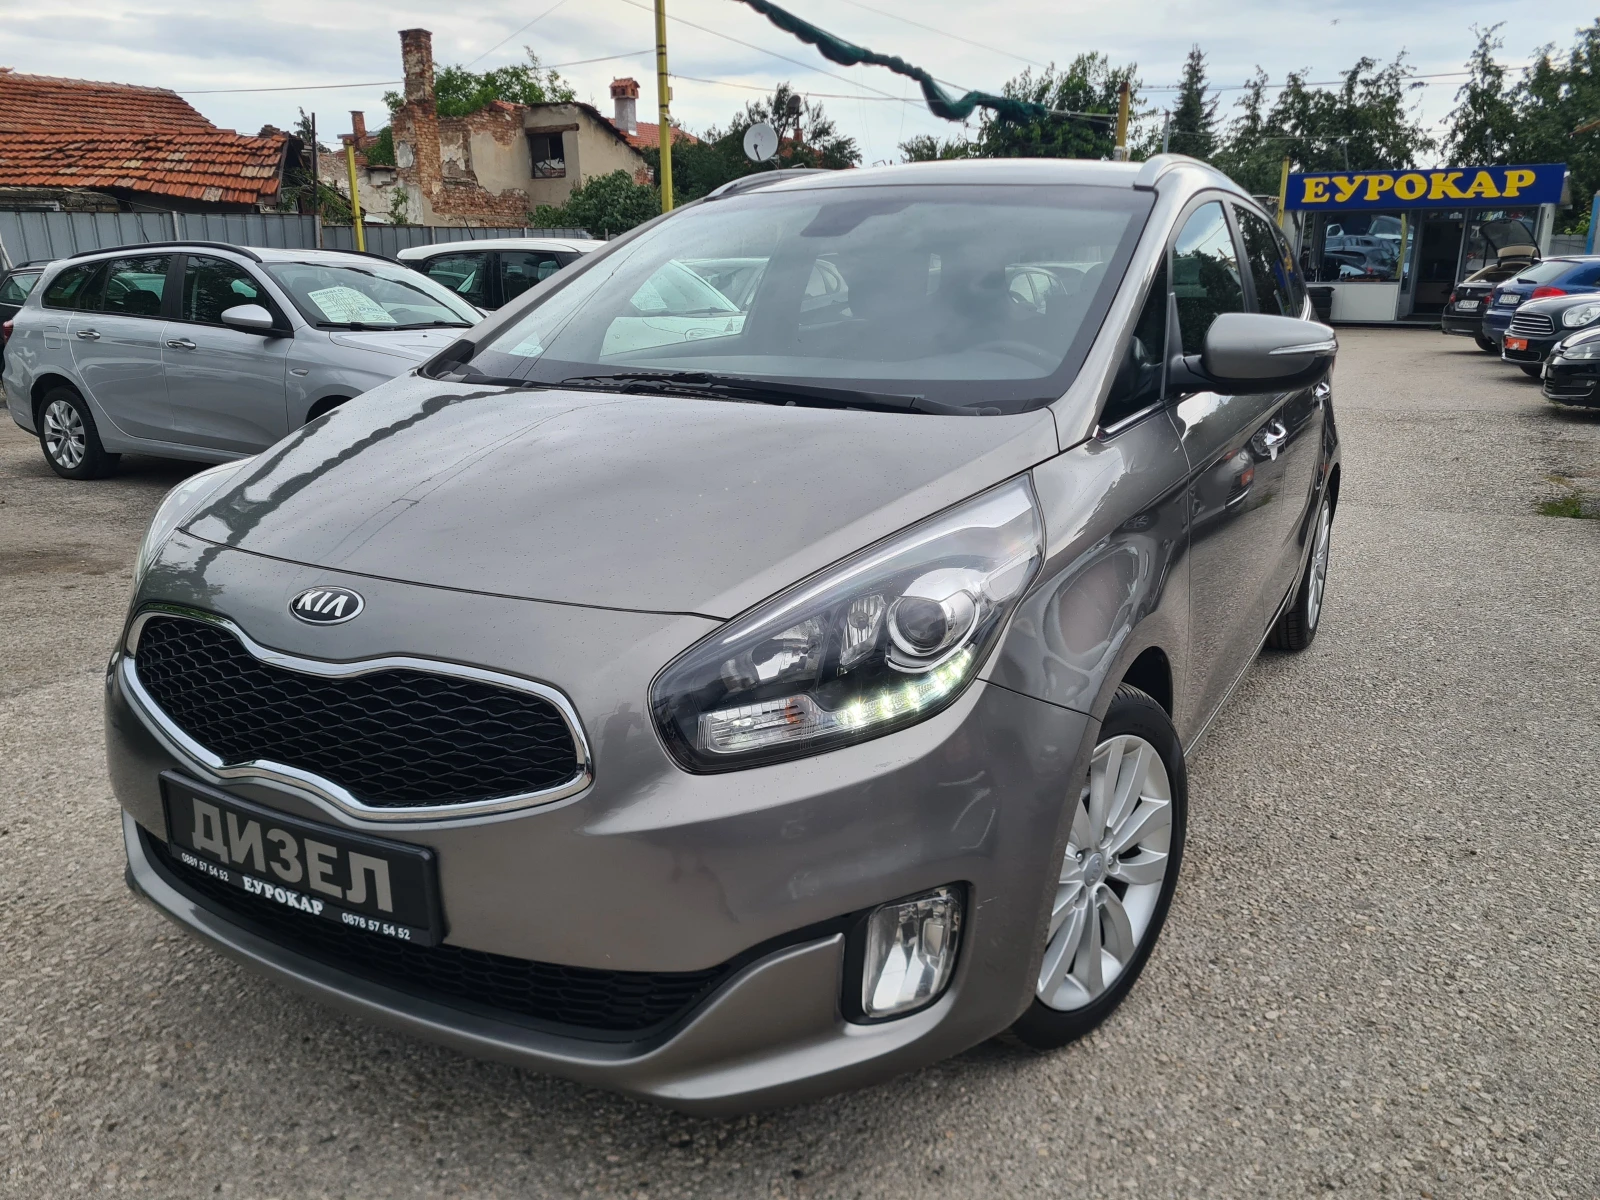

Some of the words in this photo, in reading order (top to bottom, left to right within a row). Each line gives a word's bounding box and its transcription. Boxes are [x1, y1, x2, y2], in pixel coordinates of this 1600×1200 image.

[1301, 169, 1536, 203] ЕУРОКАР
[296, 591, 349, 617] KIA
[181, 852, 198, 867] 0889
[199, 860, 207, 872] 57
[209, 865, 218, 877] 54
[219, 869, 229, 881] 52
[192, 798, 393, 912] ДИЗЕЛ
[242, 875, 324, 915] ЕУРОКАР
[341, 912, 366, 928] 0878
[368, 920, 380, 932] 57
[382, 923, 396, 936] 54
[397, 927, 411, 940] 52
